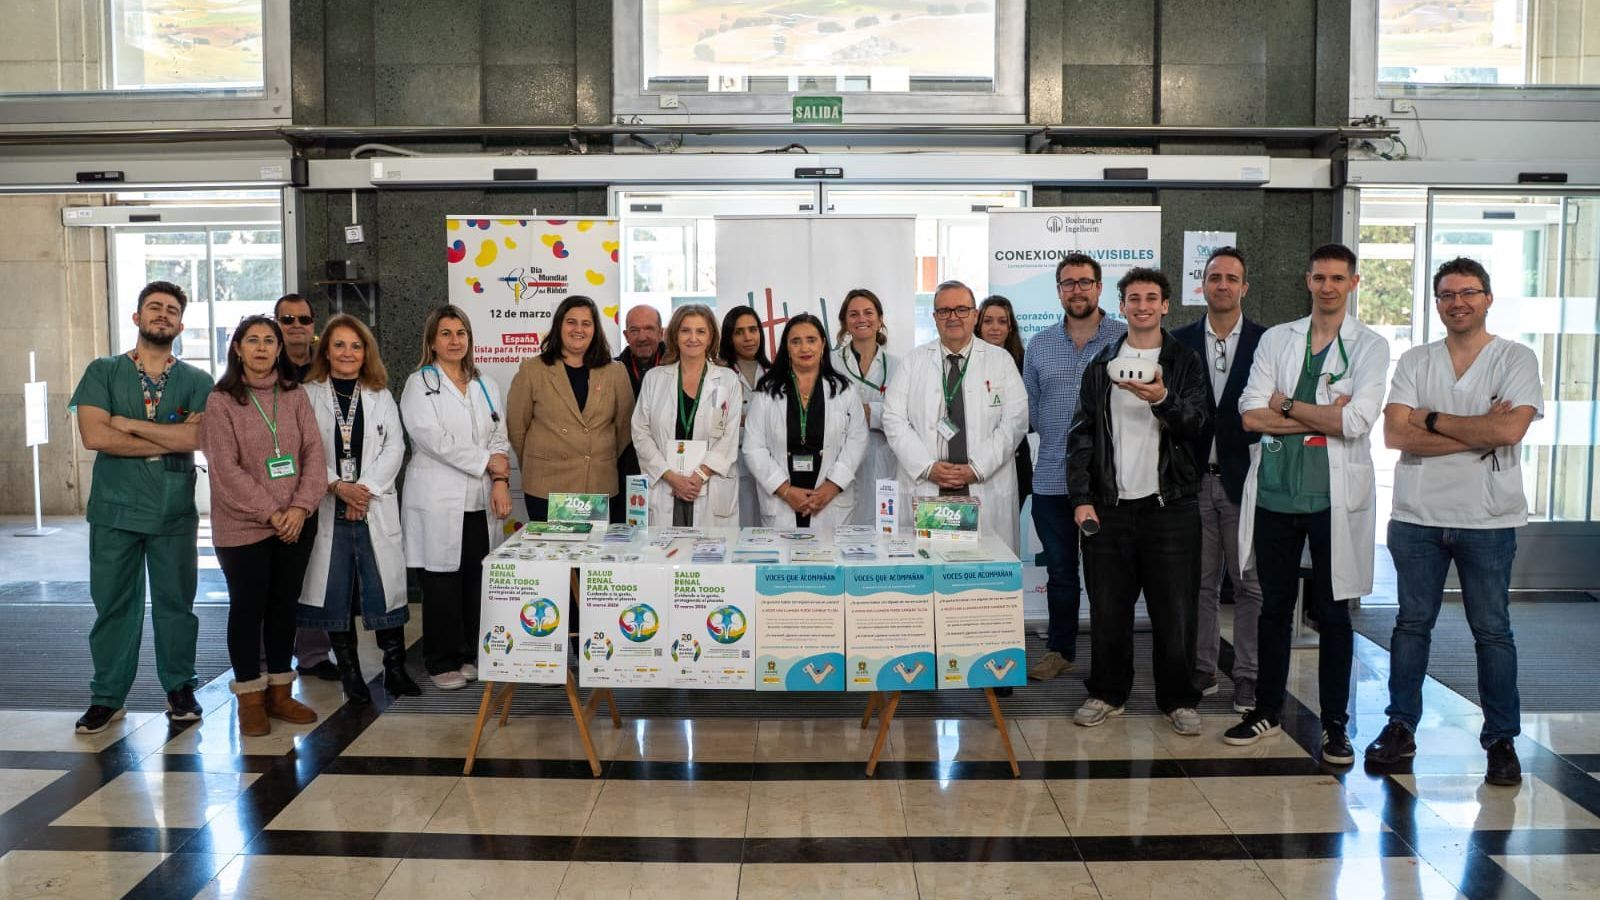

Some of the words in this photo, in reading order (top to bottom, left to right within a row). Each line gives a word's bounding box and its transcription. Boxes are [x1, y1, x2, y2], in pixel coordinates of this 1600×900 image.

[796, 106, 839, 119] SALIDA
[1065, 216, 1102, 224] Boehringer
[490, 310, 502, 318] 12
[504, 309, 516, 318] de
[1016, 311, 1054, 320] corazón
[505, 335, 537, 345] España,
[565, 497, 592, 511] 2026
[934, 506, 961, 520] 2026
[786, 574, 799, 582] QUE
[801, 572, 836, 581] ACOMPAÑAN
[875, 574, 888, 582] QUE
[889, 573, 924, 581] ACOMPAÑAN
[942, 572, 963, 580] VOCES
[964, 572, 976, 580] QUE
[978, 570, 1013, 578] ACOMPAÑAN
[593, 632, 605, 640] 20
